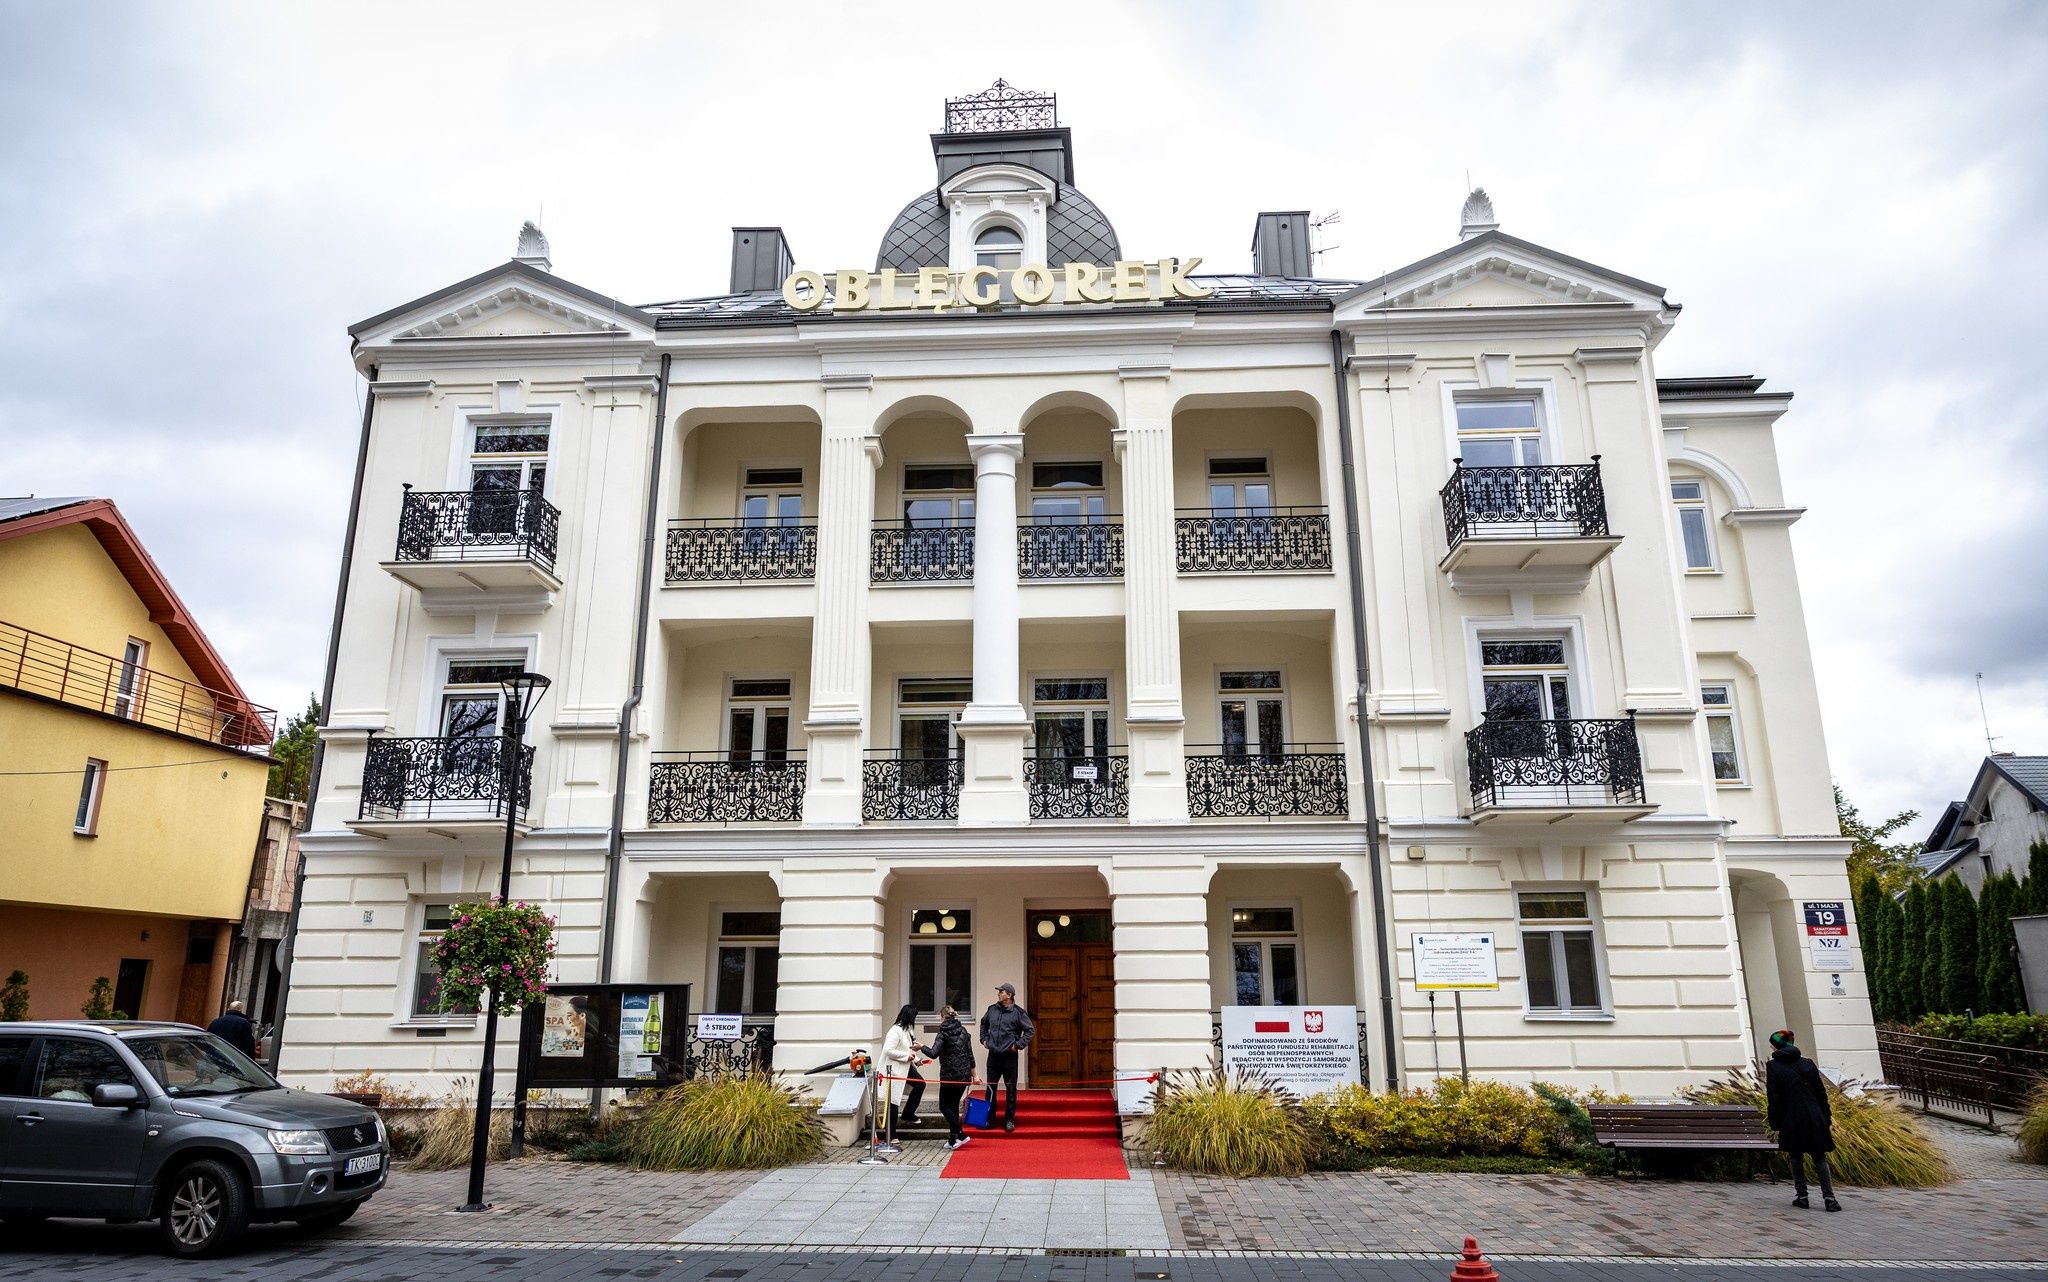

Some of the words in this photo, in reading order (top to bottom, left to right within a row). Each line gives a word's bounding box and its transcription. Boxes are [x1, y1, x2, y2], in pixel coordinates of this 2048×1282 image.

[782, 257, 1213, 314] OBLĘGOREK
[1815, 911, 1835, 925] 19
[1819, 938, 1842, 948] NFZ
[546, 1016, 564, 1025] SPA
[1306, 1036, 1339, 1044] ŚRODKÓW
[351, 1158, 361, 1171] TK
